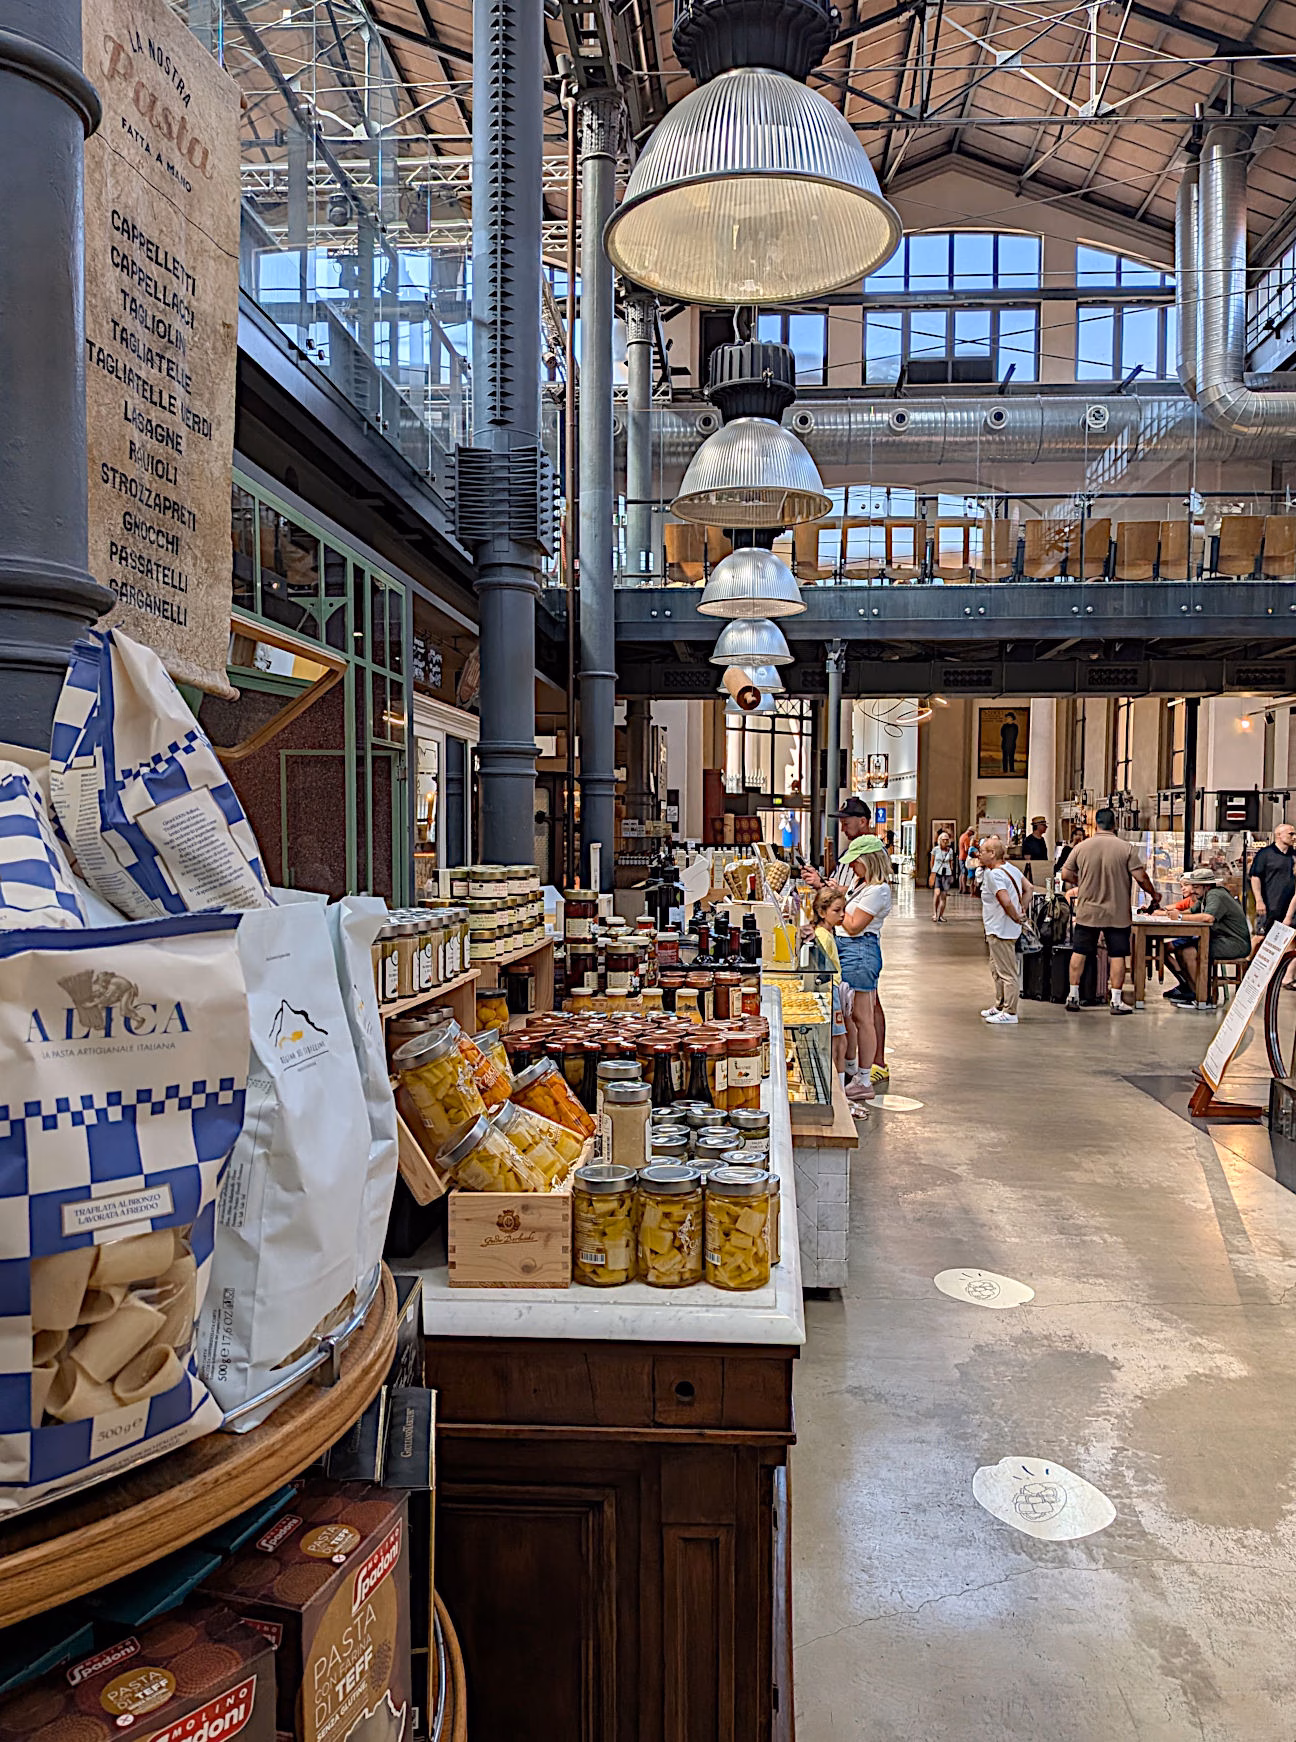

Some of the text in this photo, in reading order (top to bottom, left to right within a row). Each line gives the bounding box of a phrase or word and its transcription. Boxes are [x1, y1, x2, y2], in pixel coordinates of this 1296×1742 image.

[128, 30, 191, 108] LA NOSTRA
[100, 34, 214, 180] Pasta
[122, 117, 192, 193] FATTA A MANO
[112, 209, 196, 297] CAPPELLETTI
[110, 245, 194, 330] CAPPELLACCI
[86, 338, 212, 441] TAGLIATELLE VERDI
[124, 400, 183, 456] LASAGNE
[128, 439, 178, 486] RAVIOLI
[101, 462, 196, 532] STROZZAPRETI
[122, 511, 180, 556] GNOCCHI
[110, 540, 188, 594] PASSATELLI
[110, 578, 188, 627] GARGANELLI
[24, 1000, 193, 1044] ALICA
[51, 1048, 75, 1058] PASTA
[76, 1044, 134, 1056] ARTIGIANALE
[136, 1042, 176, 1052] ITALIANA
[74, 1193, 161, 1218] TRAFILATA AL BRONZO
[78, 1212, 120, 1225] LAVORATA
[126, 1202, 159, 1215] FREDDO
[261, 1518, 299, 1552] Spadoni
[307, 1526, 339, 1552] PASTA
[330, 1528, 350, 1546] TEFF
[368, 1528, 400, 1571] MOLINO
[352, 1540, 399, 1618] Spadoni
[71, 1645, 136, 1686] Spadoni
[314, 1603, 376, 1690] PASTA
[316, 1633, 372, 1704] CON FARINA
[107, 1671, 162, 1702] PASTA
[116, 1678, 169, 1710] DI TEFF
[316, 1644, 374, 1729] DI TEFF
[172, 1687, 248, 1740] MOLINO
[316, 1713, 340, 1740] SENZA
